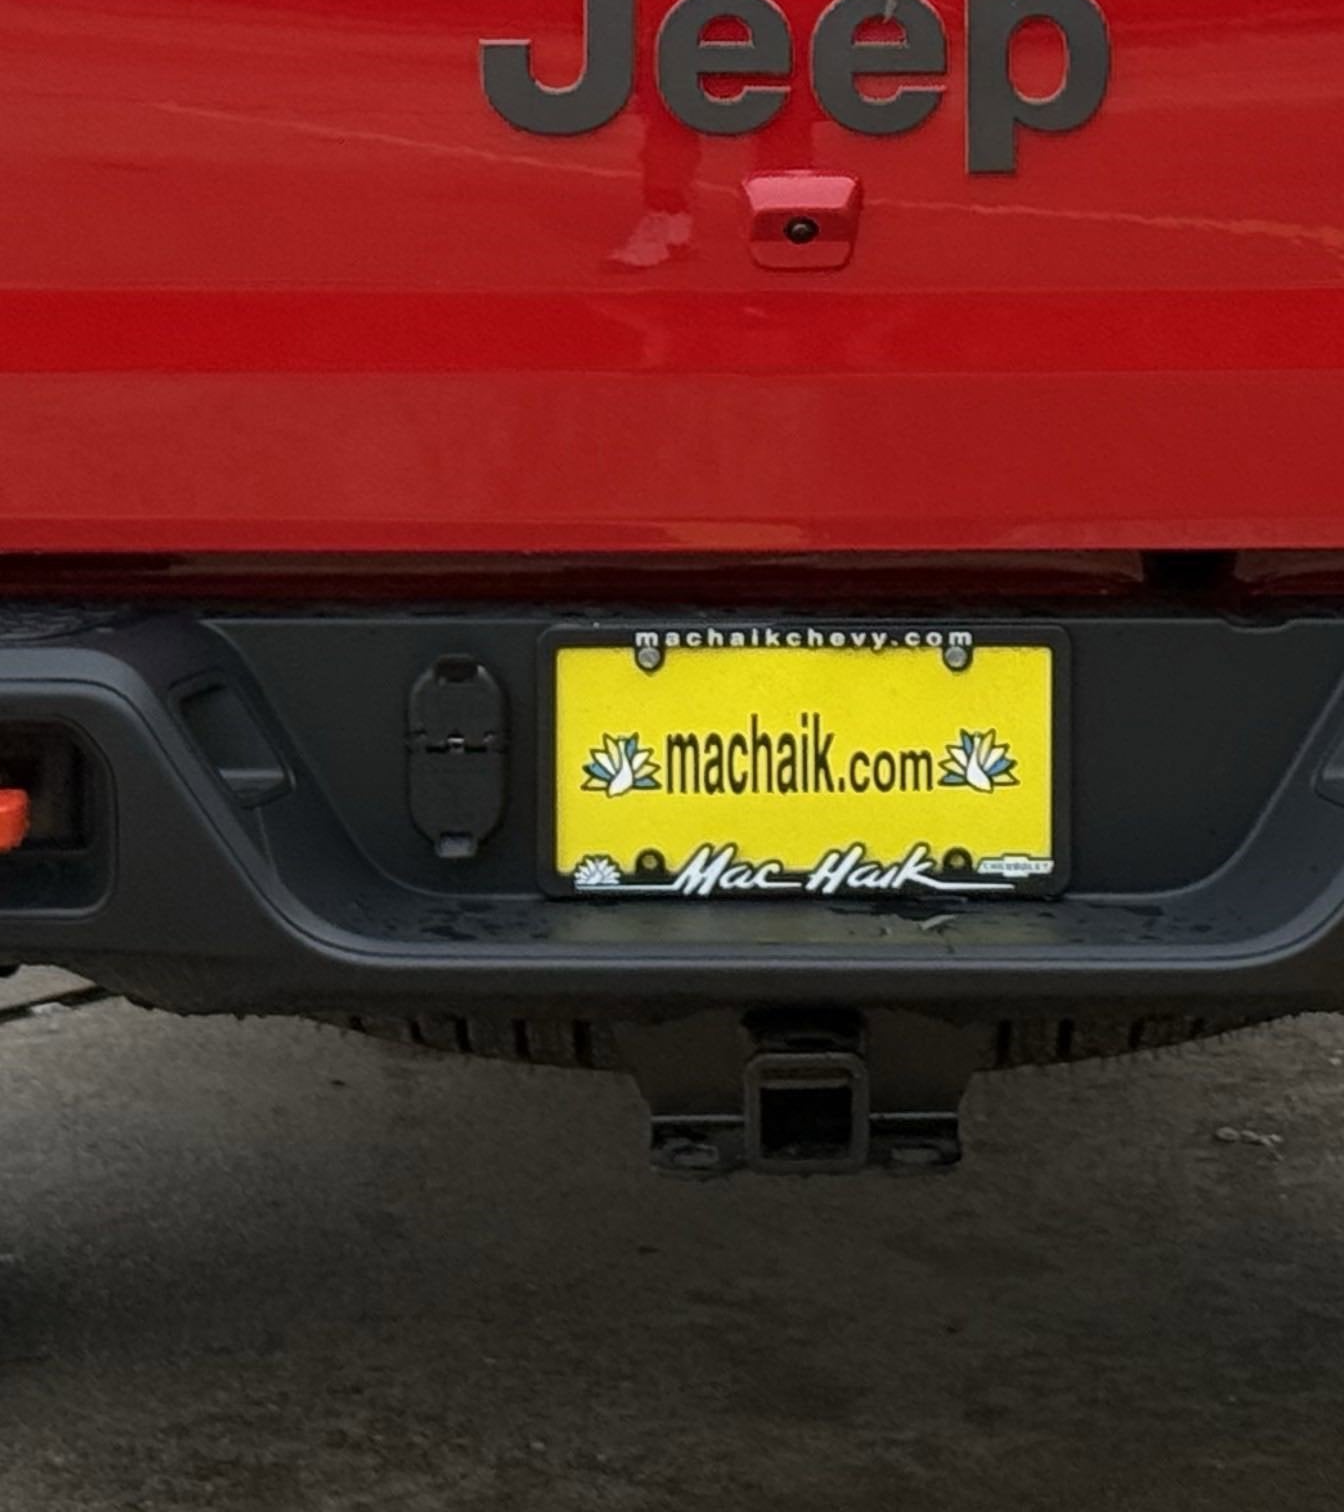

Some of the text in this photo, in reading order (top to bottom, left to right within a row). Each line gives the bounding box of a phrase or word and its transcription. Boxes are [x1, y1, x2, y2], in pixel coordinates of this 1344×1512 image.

[635, 628, 973, 650] machaikchevy.com
[666, 712, 934, 794] machaik.com
[671, 843, 801, 896] Mac
[805, 842, 946, 894] Haik
